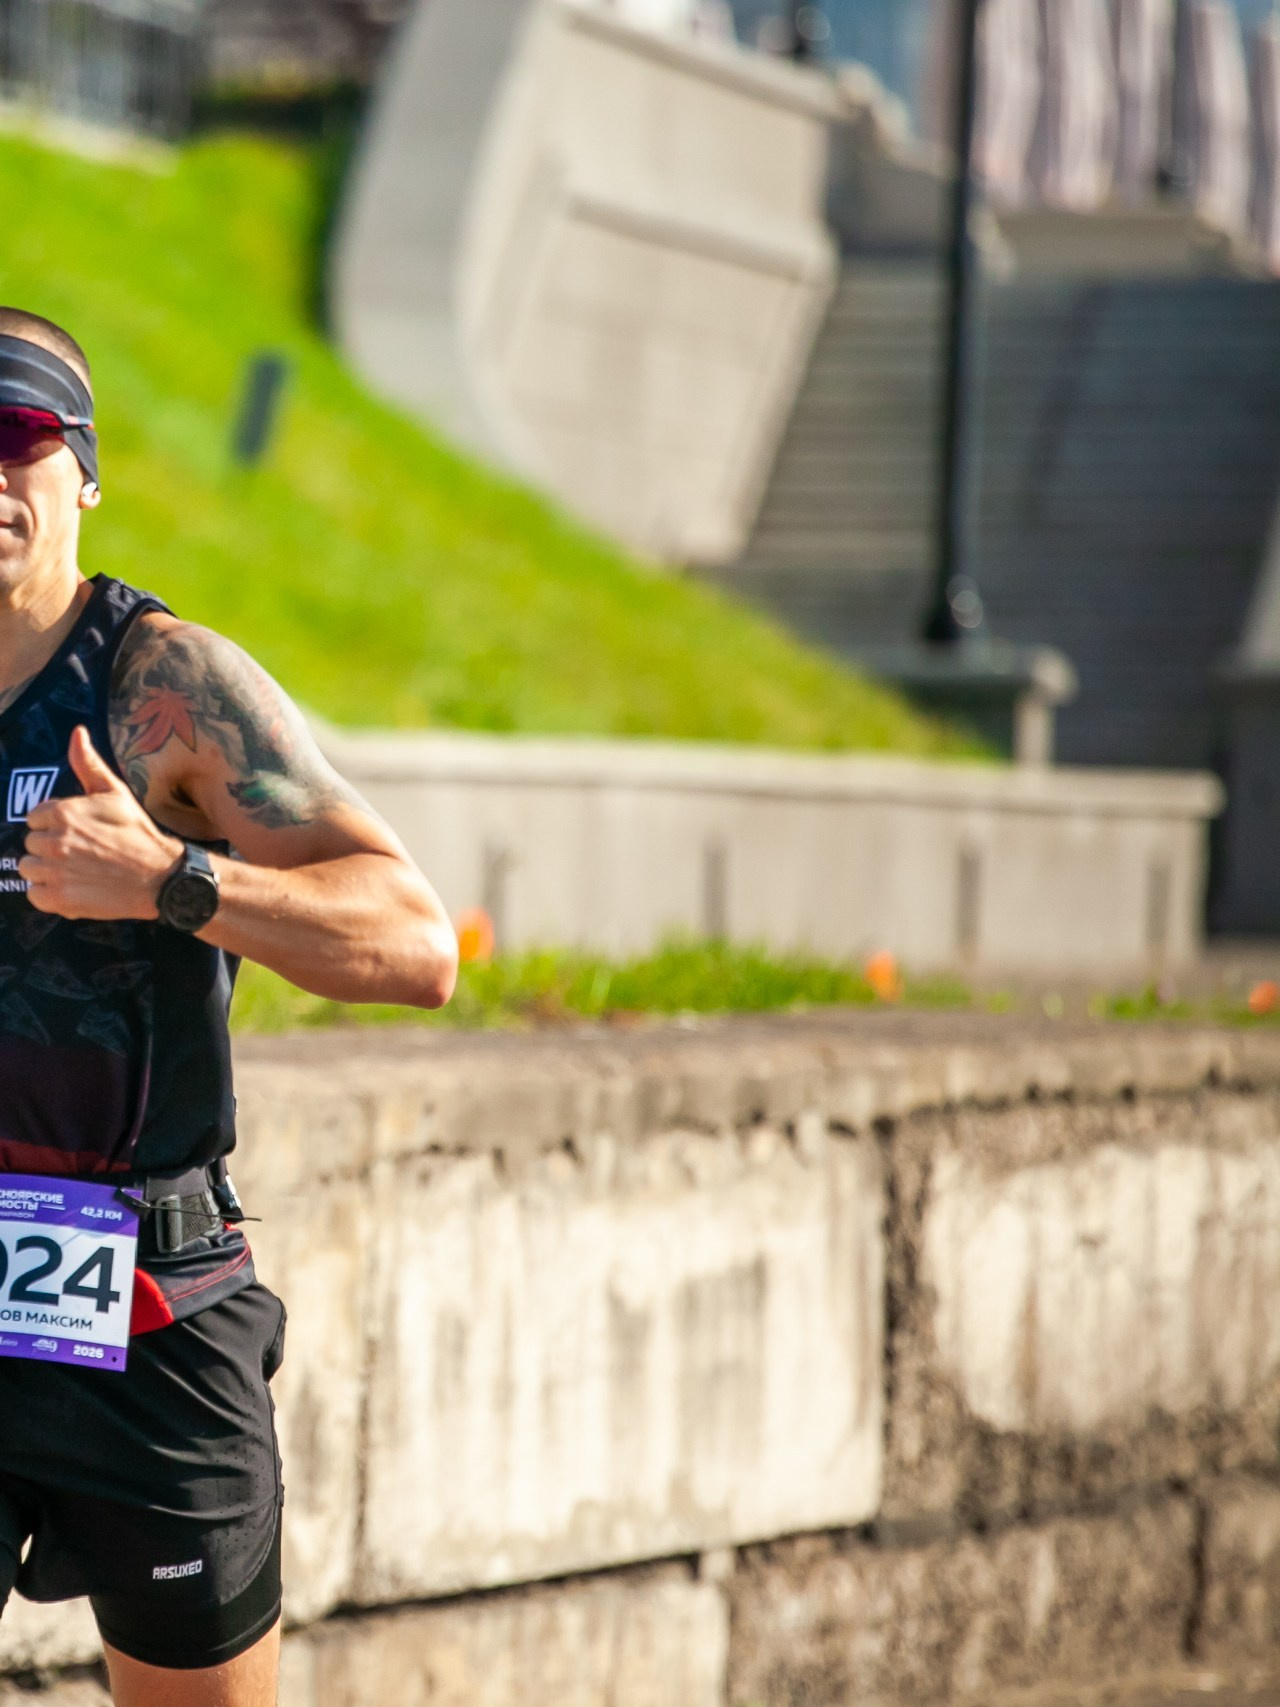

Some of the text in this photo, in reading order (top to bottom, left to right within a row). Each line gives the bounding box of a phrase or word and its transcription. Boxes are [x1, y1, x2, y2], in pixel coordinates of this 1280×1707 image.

[80, 1206, 123, 1221] 42,2 КМ
[26, 1311, 93, 1331] МАКСИМ
[73, 1344, 104, 1359] 2026
[152, 1559, 203, 1579] ARSUXED
